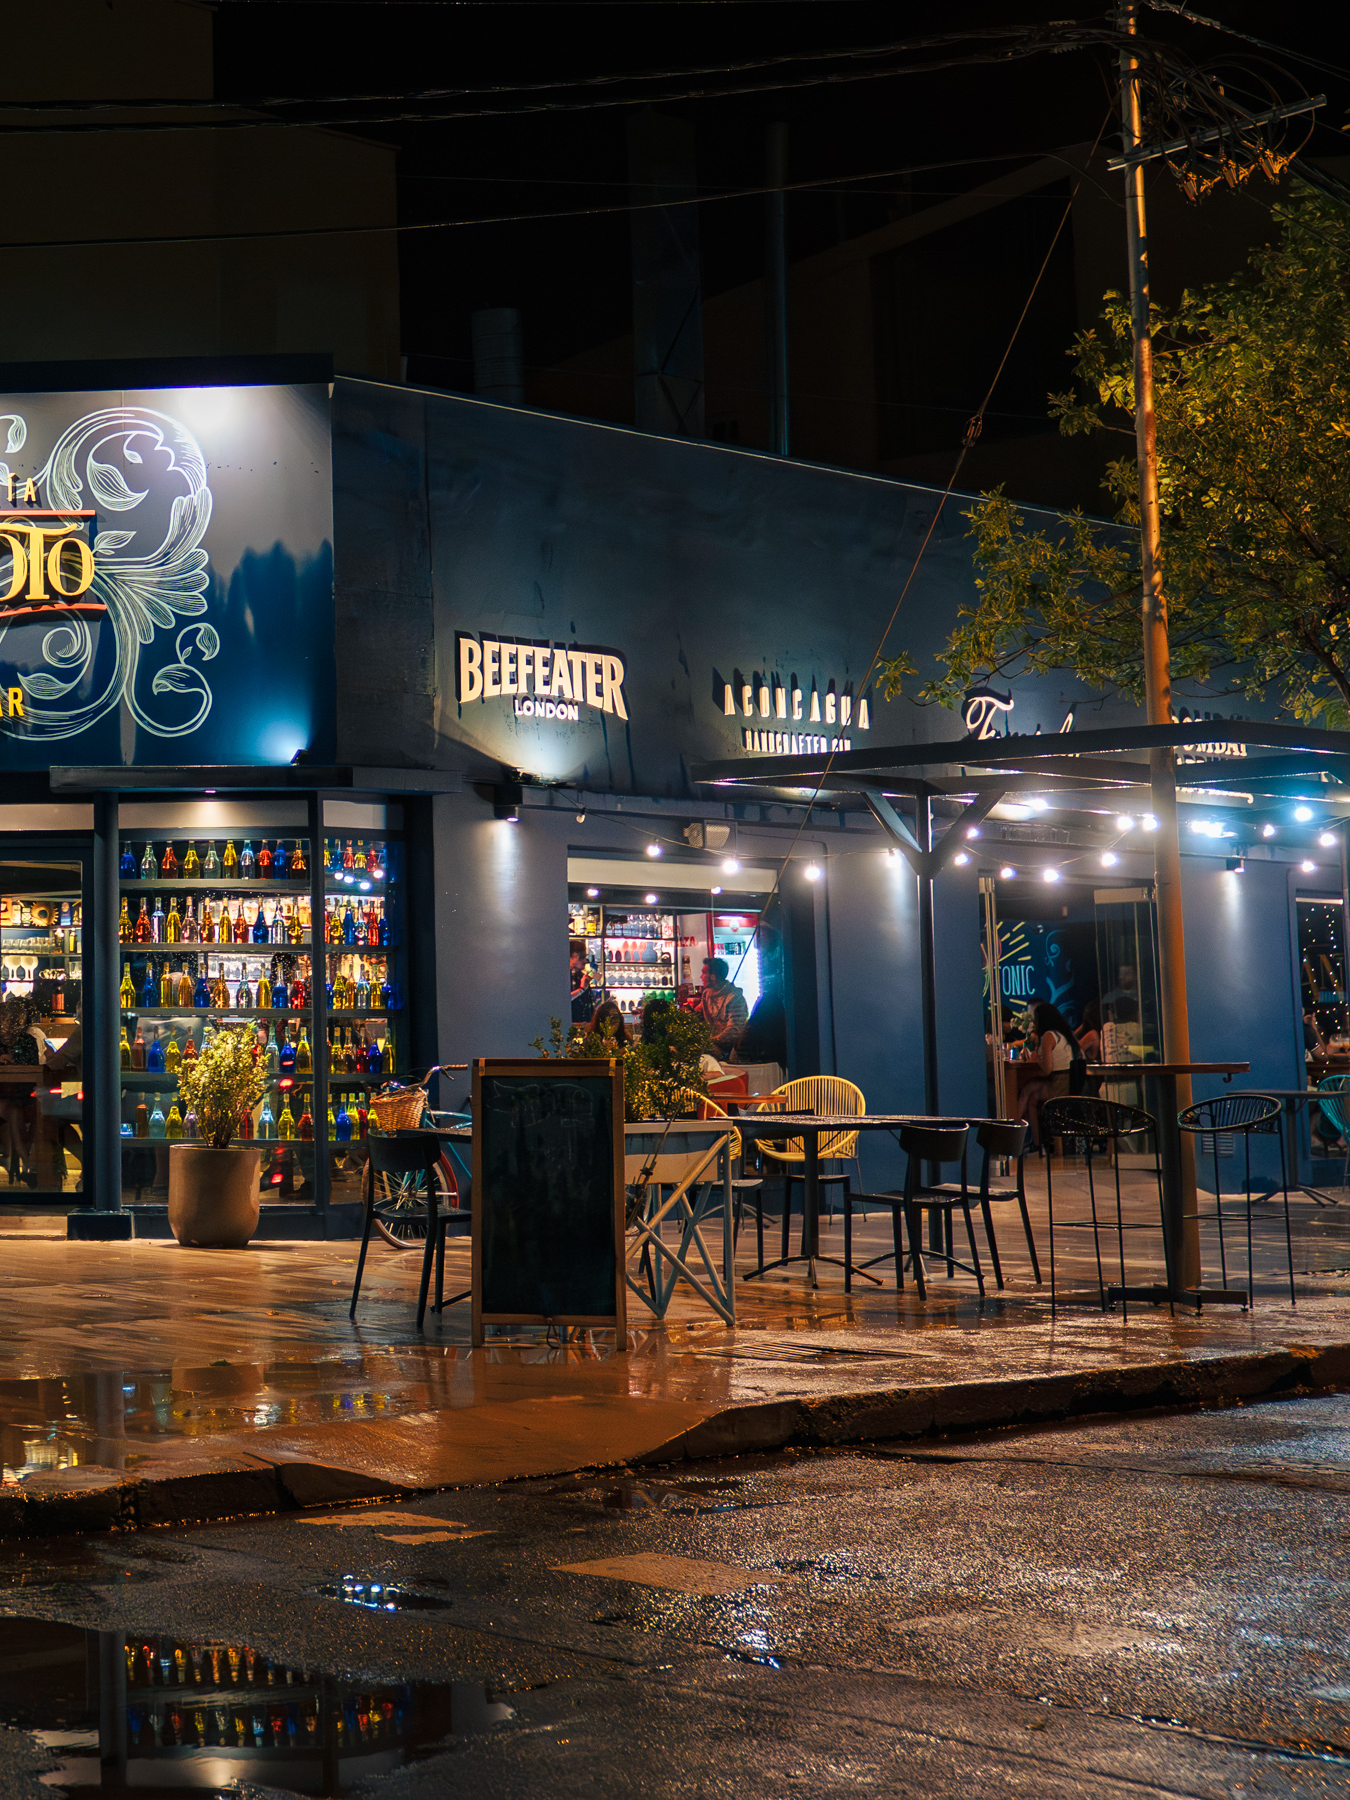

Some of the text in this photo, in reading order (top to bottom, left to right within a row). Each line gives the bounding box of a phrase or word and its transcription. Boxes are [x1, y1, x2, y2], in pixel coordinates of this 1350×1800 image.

[459, 637, 629, 721] BEEFEATER
[514, 699, 579, 721] LONDON
[723, 684, 870, 730] ACONCAGUA
